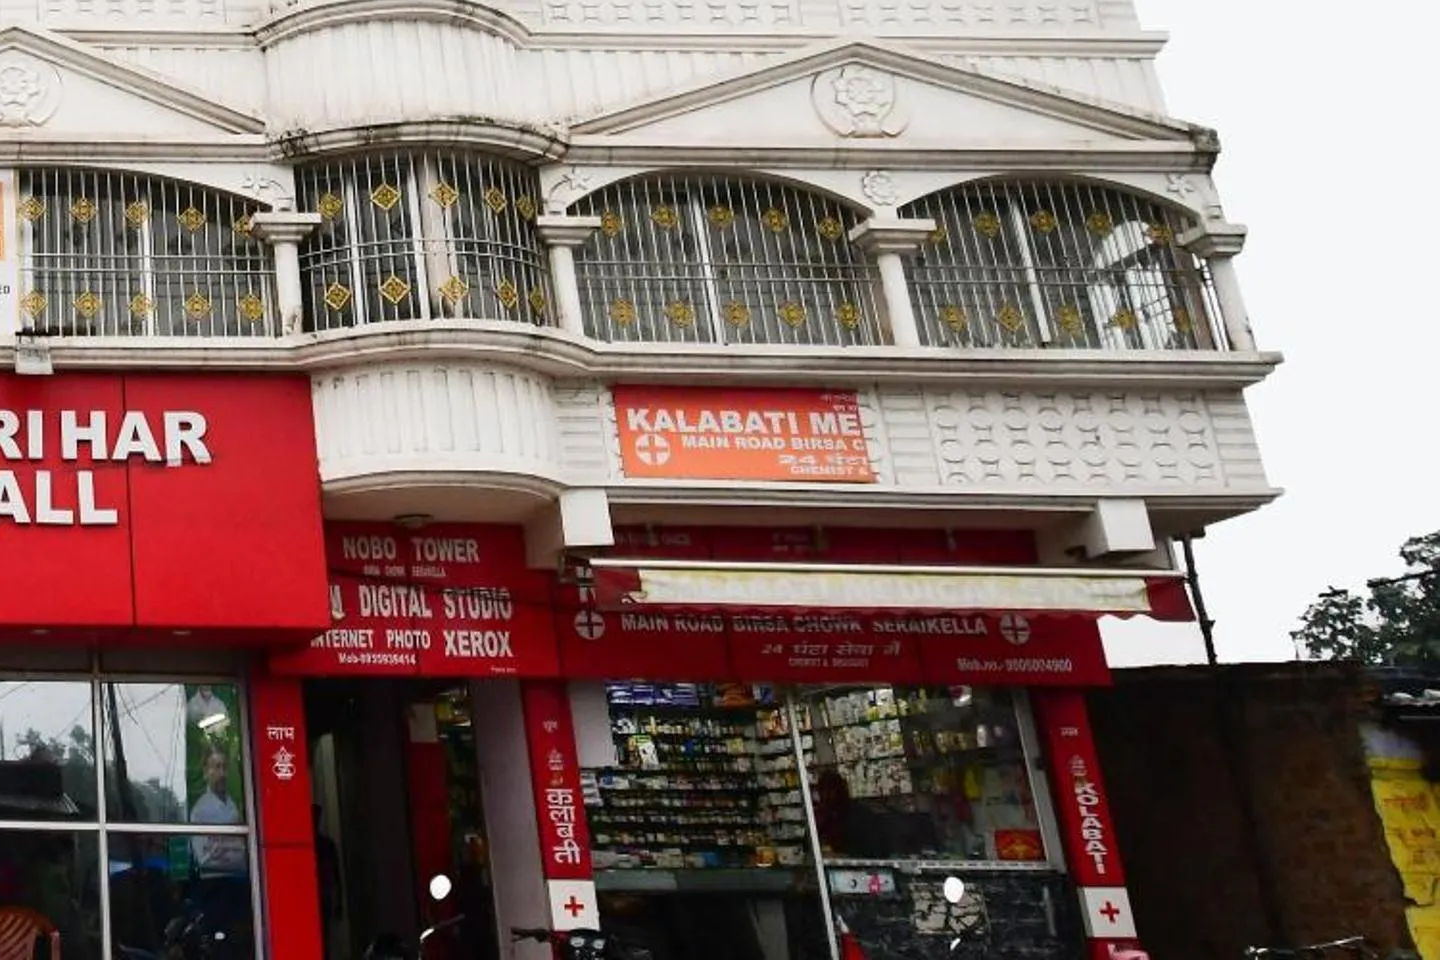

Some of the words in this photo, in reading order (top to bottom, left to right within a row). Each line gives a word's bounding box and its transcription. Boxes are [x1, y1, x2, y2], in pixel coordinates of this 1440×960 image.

[626, 407, 800, 435] KALABATI
[809, 411, 861, 437] ME
[680, 434, 731, 449] MAIN
[735, 436, 786, 450] ROAD
[791, 437, 848, 451] BIRSA
[343, 536, 396, 560] NOBO
[413, 536, 481, 563] TOWER
[358, 583, 433, 618] DIGITAL
[442, 586, 513, 620] STUDIO
[621, 614, 669, 632] MAIN
[675, 615, 724, 632] ROAD
[732, 616, 789, 633] BIRSA
[793, 617, 862, 634] CHOWK
[872, 617, 988, 635] SERAIKELLA
[386, 629, 431, 650] PHOTO
[442, 630, 513, 658] XEROX
[761, 643, 783, 654] 24
